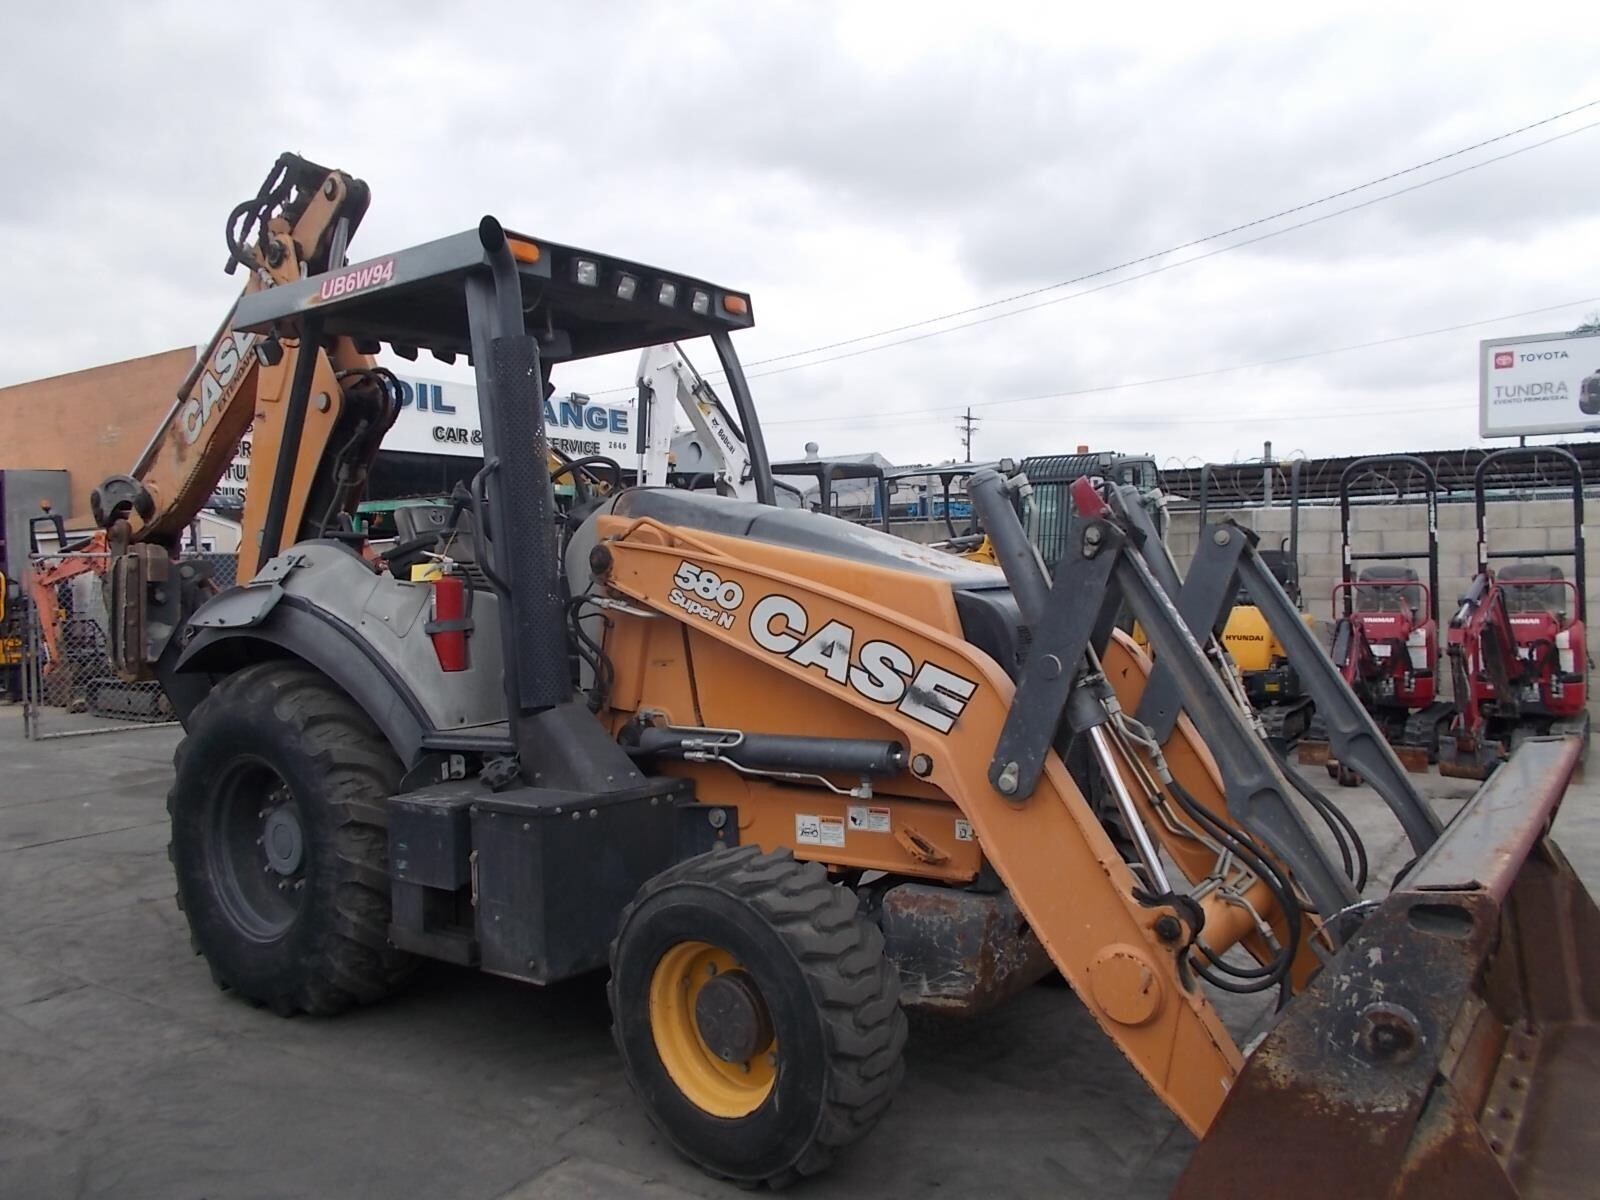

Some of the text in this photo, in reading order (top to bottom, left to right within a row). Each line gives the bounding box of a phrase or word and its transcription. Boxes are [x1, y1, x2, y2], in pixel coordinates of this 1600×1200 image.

[321, 260, 394, 300] UB6W94
[1519, 351, 1569, 362] TOYOTA
[1495, 381, 1568, 398] TUNDRA
[433, 425, 469, 445] CAR
[717, 428, 736, 455] Bobcat
[673, 559, 745, 611] 580
[667, 587, 737, 631] Super N
[749, 593, 980, 736] CASE
